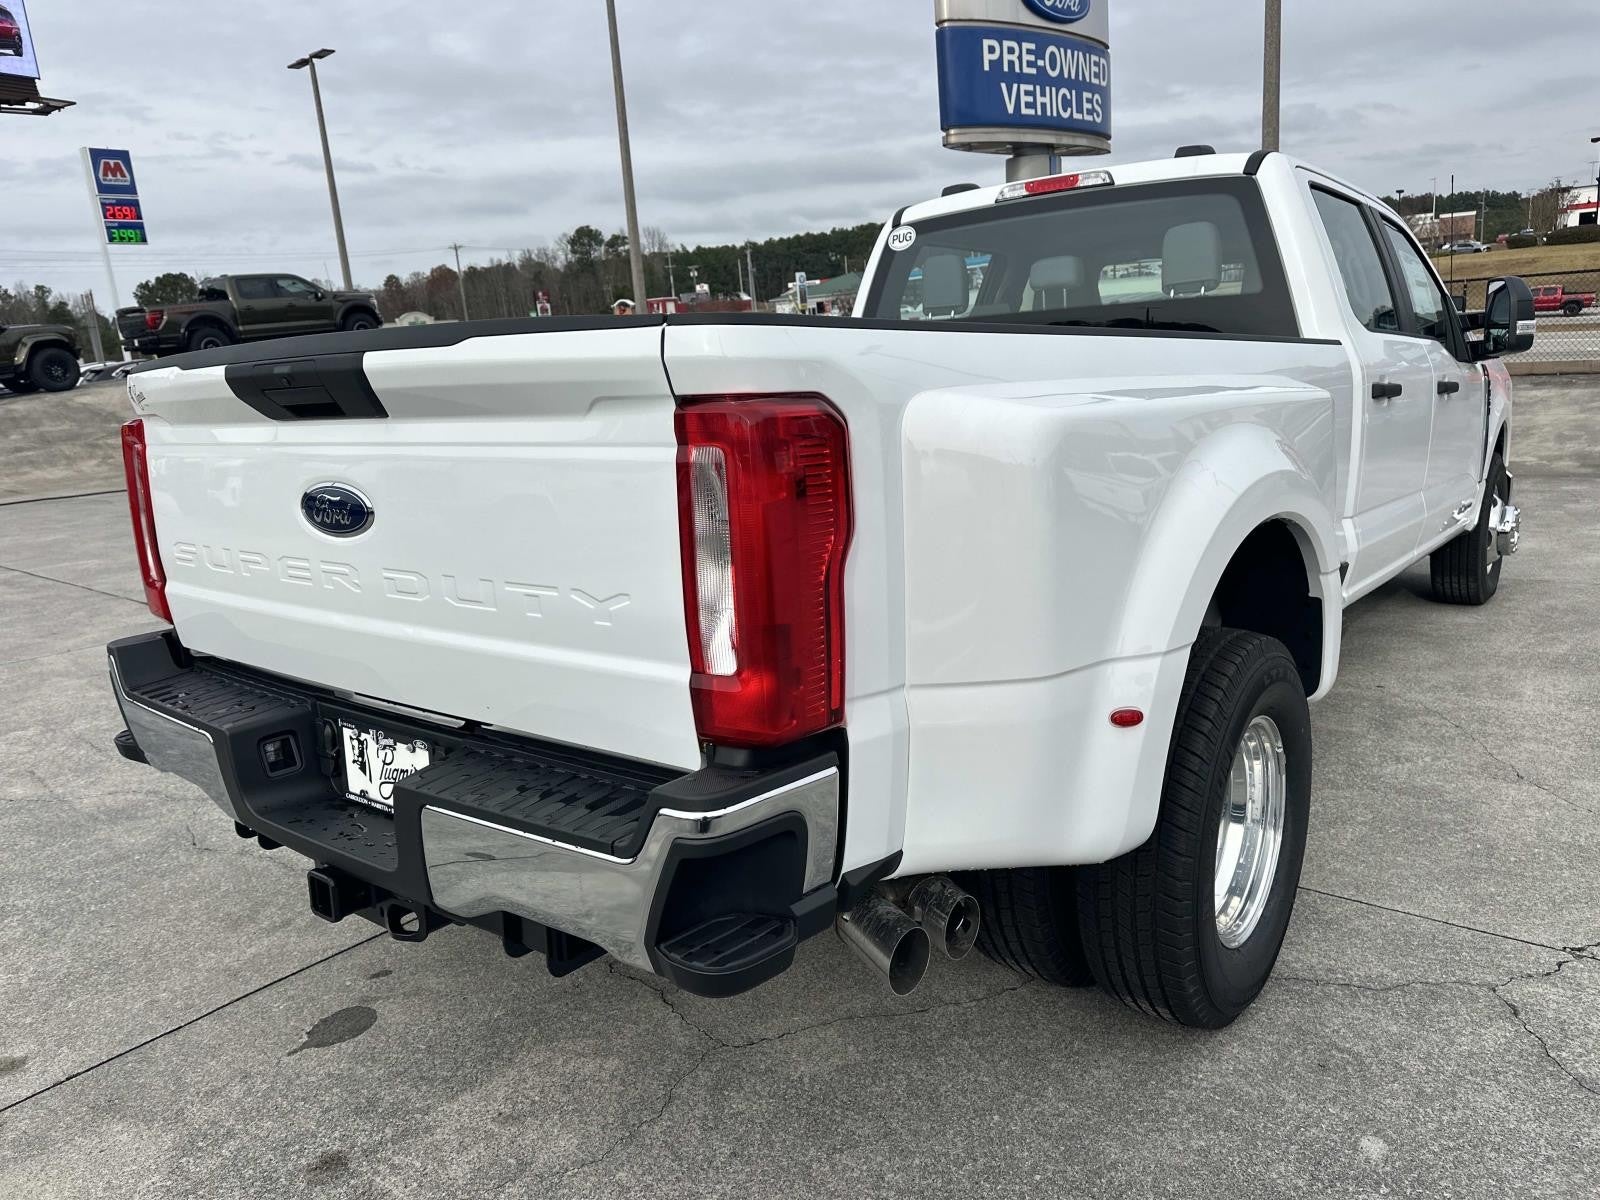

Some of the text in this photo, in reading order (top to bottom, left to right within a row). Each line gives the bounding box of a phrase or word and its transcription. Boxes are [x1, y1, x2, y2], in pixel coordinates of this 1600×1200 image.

[982, 38, 1108, 87] PRE-OWNED
[1000, 82, 1103, 123] VEHICLES
[892, 231, 913, 245] PUG
[313, 493, 352, 525] Ford
[173, 541, 631, 626] SUPER DUTY
